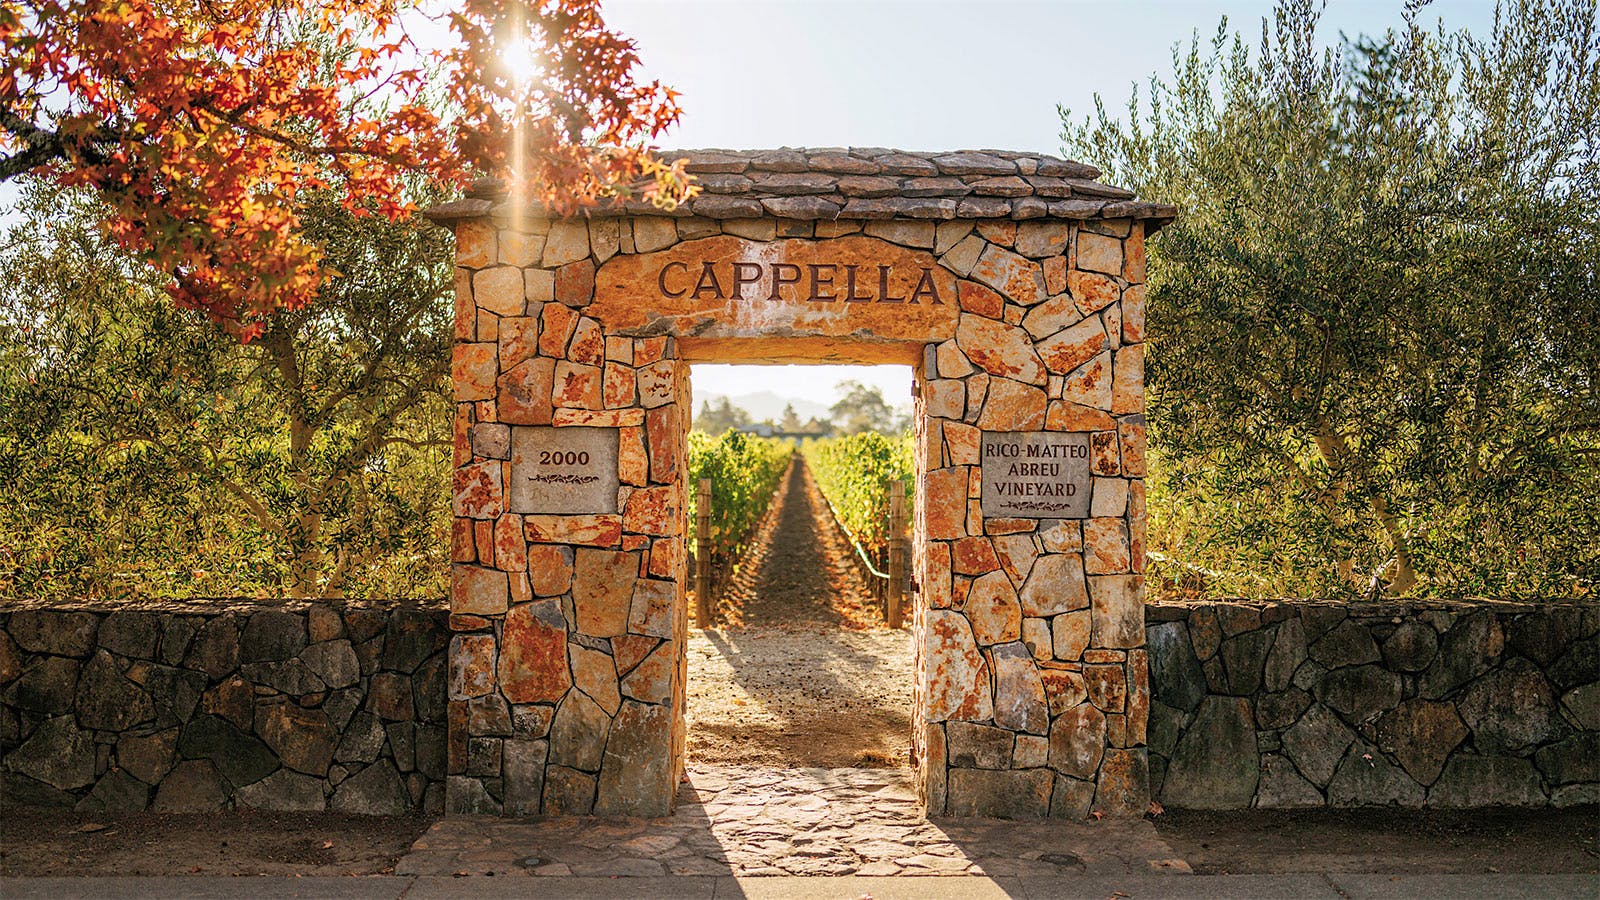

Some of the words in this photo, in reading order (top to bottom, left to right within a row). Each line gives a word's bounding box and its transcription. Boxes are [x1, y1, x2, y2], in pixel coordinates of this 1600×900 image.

[658, 261, 944, 304] CAPPELLA
[986, 443, 1087, 458] RICO-MATTEO
[539, 451, 590, 465] 2000
[1008, 463, 1060, 476] ABREU
[994, 482, 1076, 496] VINEYARD
